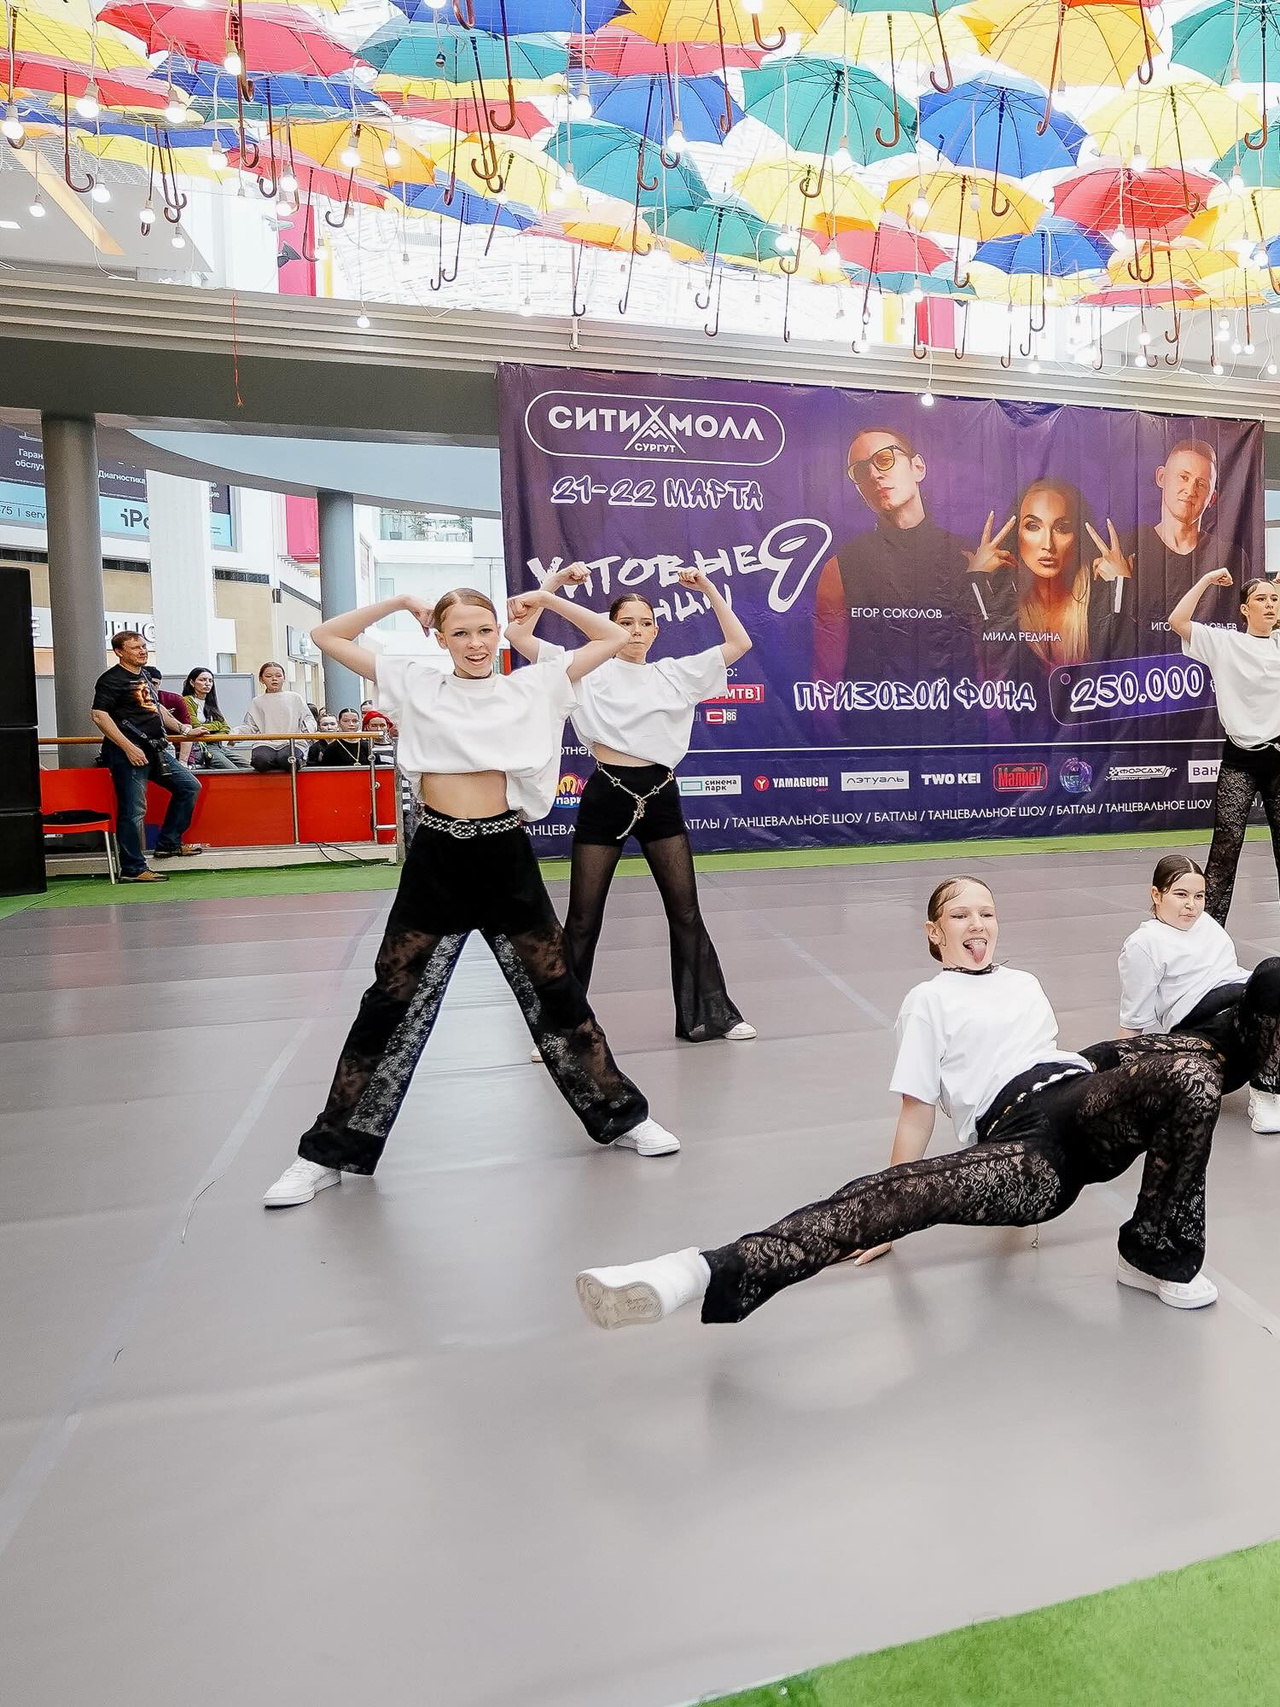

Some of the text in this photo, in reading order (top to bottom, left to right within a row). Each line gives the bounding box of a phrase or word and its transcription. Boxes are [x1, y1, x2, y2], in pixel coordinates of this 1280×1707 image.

[634, 442, 676, 453] СУРГУТ
[18, 448, 44, 460] Гаран
[98, 469, 146, 485] Диагностика
[550, 474, 764, 511] 21-22 МАРТА
[25, 509, 46, 519] serv
[851, 607, 943, 619] ЕГОР СОКОЛОВ
[982, 632, 1062, 643] МИЛА РЕДИНА
[793, 677, 950, 711] ПРИЗОВОЙ
[1069, 663, 1204, 713] 250.000
[773, 777, 829, 788] YAMAGUCHI
[921, 773, 981, 785] TWO KEI
[732, 813, 829, 829] ТАНЦЕВАЛЬНОЕ
[832, 812, 863, 824] ШОУ
[928, 806, 1017, 820] ТАНЦЕВАЛЬНОЕ
[1019, 805, 1047, 817] ШОУ
[1105, 800, 1185, 813] ТАНЦЕВАЛЬНОЕ
[1187, 799, 1213, 810] ШОУ
